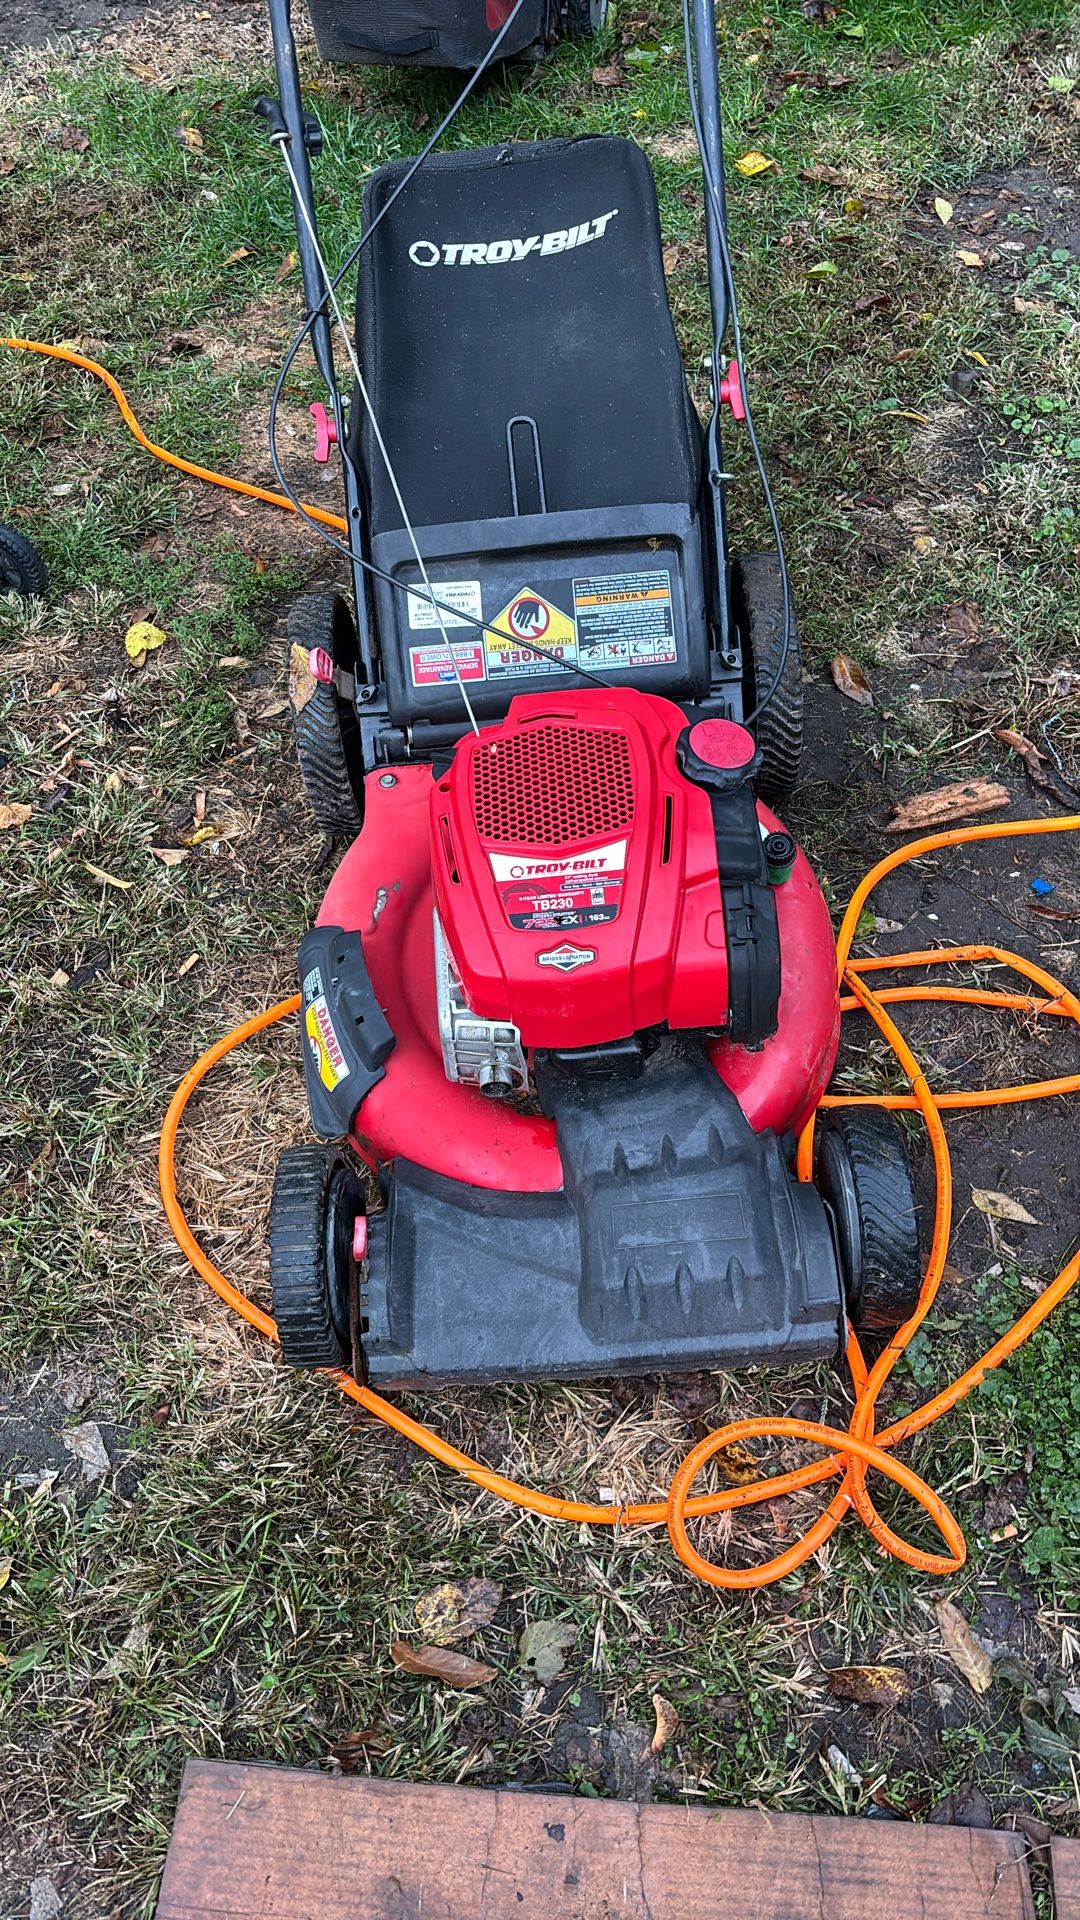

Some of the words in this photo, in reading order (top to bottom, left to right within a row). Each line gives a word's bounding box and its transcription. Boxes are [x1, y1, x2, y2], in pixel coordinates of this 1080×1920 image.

[441, 209, 613, 266] TROY-BILT
[596, 592, 639, 602] WARNING
[534, 638, 556, 647] HANDS
[556, 637, 571, 645] KEEP
[490, 643, 507, 651] AWAY
[632, 653, 665, 664] DANGER
[418, 664, 453, 674] ADVANTAGE
[455, 662, 479, 670] SERVIC
[526, 858, 608, 876] TROY-BILT
[532, 897, 574, 911] TB230
[317, 1007, 343, 1069] DANGER
[725, 1426, 734, 1435] OF
[735, 1422, 751, 1432] RISK
[693, 1431, 724, 1457] BURSTING
[682, 1459, 693, 1471] DO
[677, 1470, 687, 1486] NOT
[671, 1485, 679, 1500] USE
[848, 1454, 856, 1484] CAUTION
[896, 1547, 909, 1558] DO
[908, 1553, 924, 1566] NOT
[925, 1560, 940, 1571] USE
